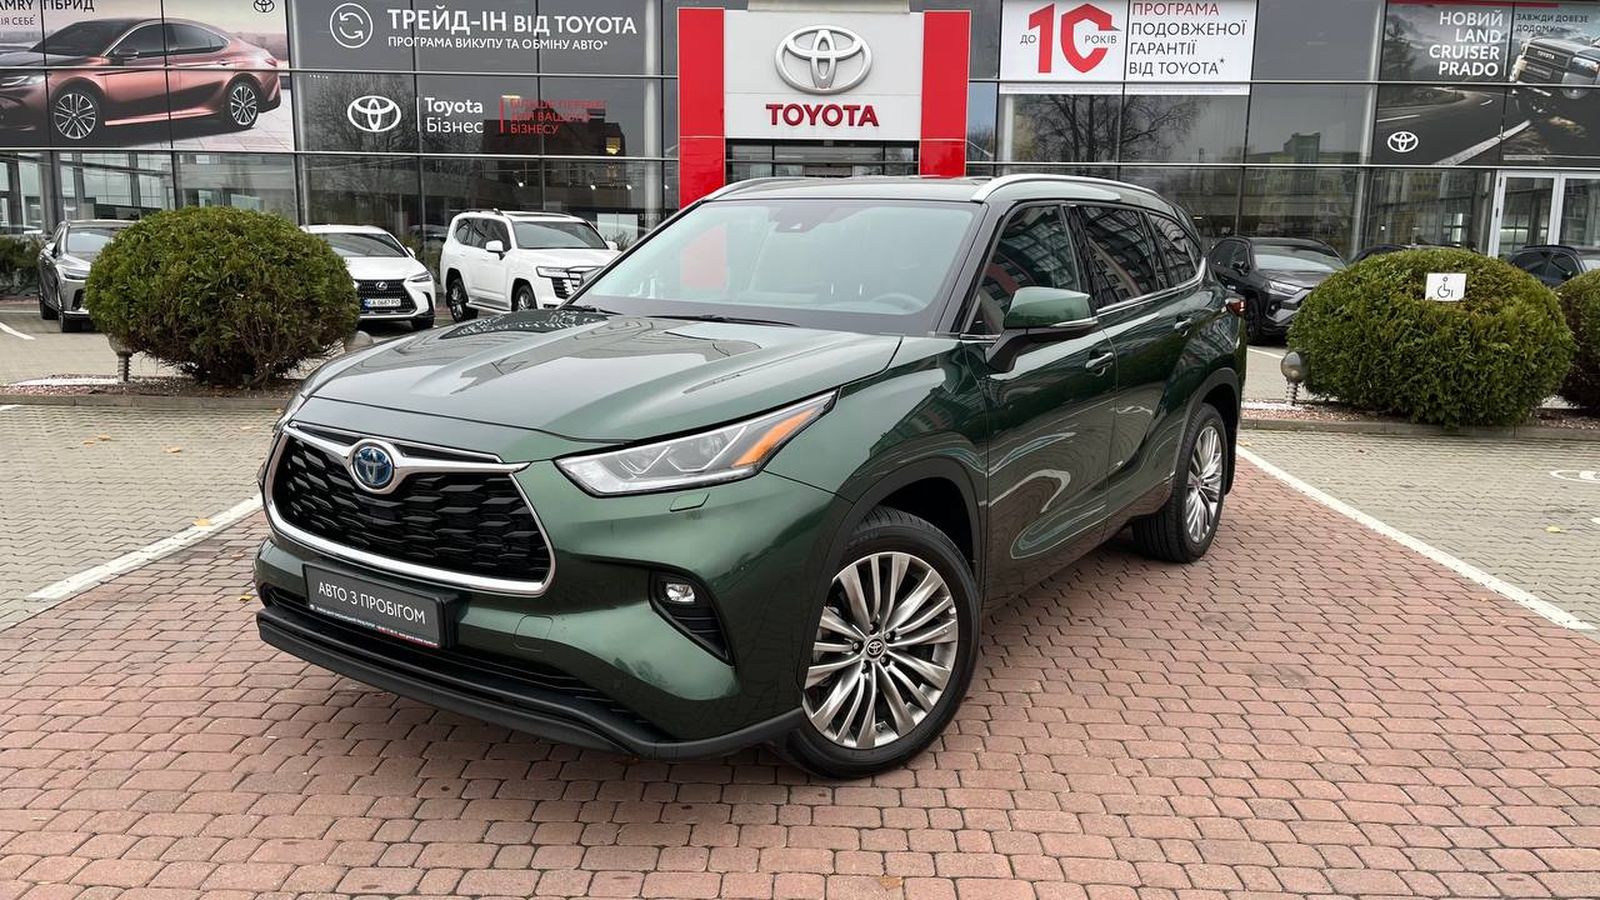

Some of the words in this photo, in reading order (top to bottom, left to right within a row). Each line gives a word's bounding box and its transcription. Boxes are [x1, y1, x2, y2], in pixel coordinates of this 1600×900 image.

[1132, 3, 1219, 16] ПРОГРАМА
[387, 5, 507, 35] ТРЕЙД-ІН
[514, 15, 550, 36] ВІД
[554, 16, 637, 34] TOYOTA
[1439, 10, 1503, 26] НОВИЙ
[1516, 13, 1553, 22] ЗАВЖДИ
[1131, 20, 1247, 37] ПОДОВЖЕНОЇ
[1455, 28, 1501, 43] LAND
[388, 36, 452, 48] ПРОГРАМА
[455, 37, 503, 49] ВИКУПУ
[506, 38, 520, 49] ТА
[522, 39, 569, 50] ОБМІНУ
[1020, 35, 1037, 45] ДО
[1084, 35, 1117, 44] РОКІВ
[1130, 40, 1197, 55] ГАРАНТІЇ
[1429, 44, 1500, 60] CRUISER
[1129, 61, 1153, 76] ВІД
[1438, 62, 1498, 76] PRADO
[424, 97, 483, 116] Toyota
[766, 103, 880, 127] TOYOTA
[426, 117, 484, 133] Бізнес
[510, 124, 559, 135] БІЗНЕСУ
[318, 582, 347, 602] АВТО
[349, 591, 358, 605] З
[360, 593, 426, 625] ПРОБІГОМ
